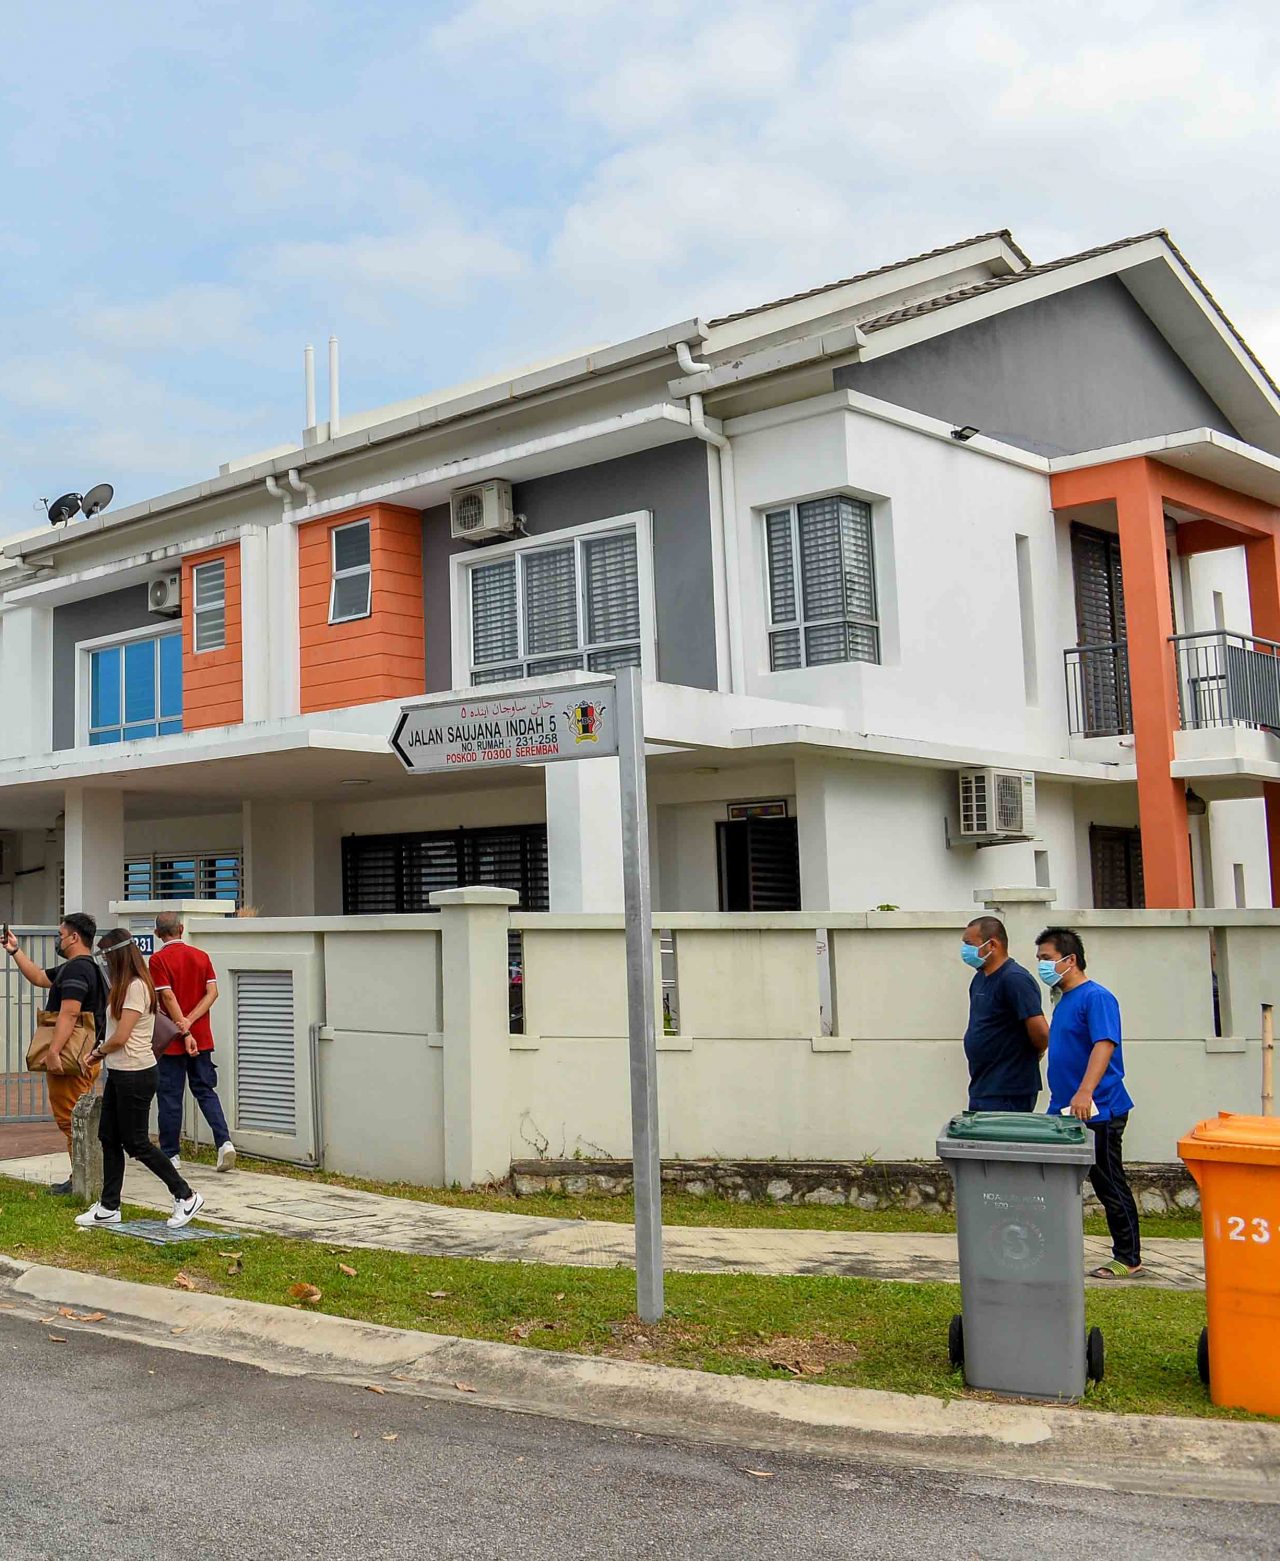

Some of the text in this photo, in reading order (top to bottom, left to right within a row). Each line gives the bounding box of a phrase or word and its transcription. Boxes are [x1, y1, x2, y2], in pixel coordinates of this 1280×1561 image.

[408, 715, 557, 747] JALAN SAUJANA INDAH 5
[461, 742, 475, 752] NO.
[477, 738, 504, 751] RUMAH
[516, 733, 558, 747] 231-258
[446, 744, 559, 764] POSKOD 70300 SEREMBAN
